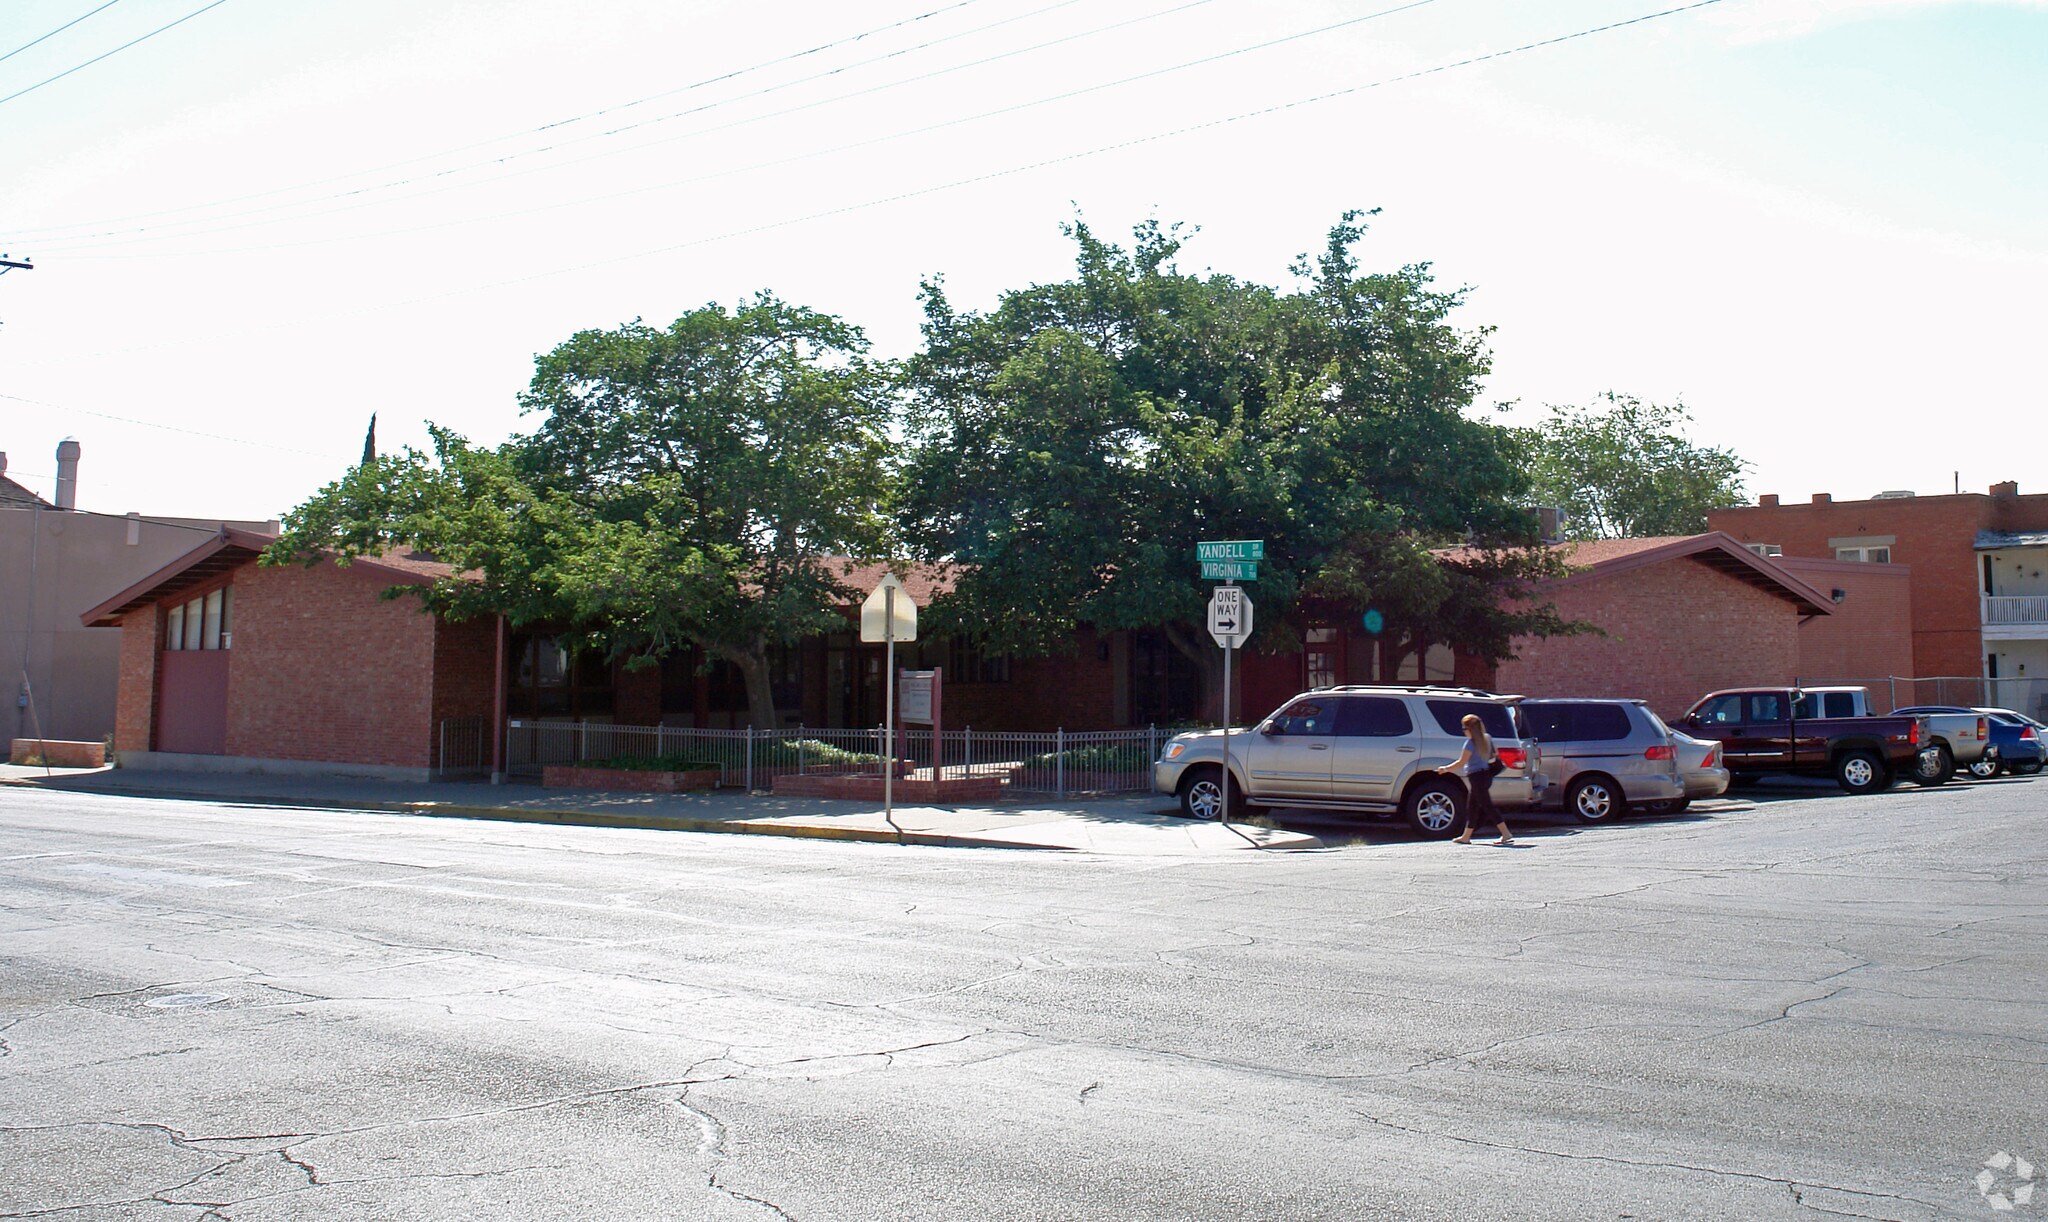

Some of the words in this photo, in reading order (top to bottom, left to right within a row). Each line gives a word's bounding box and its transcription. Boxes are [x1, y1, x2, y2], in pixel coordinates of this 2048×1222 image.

[1199, 544, 1245, 558] YANDELL
[1203, 563, 1243, 577] VIRGINIA
[1217, 591, 1237, 602] ONE
[1217, 604, 1238, 615] WAY
